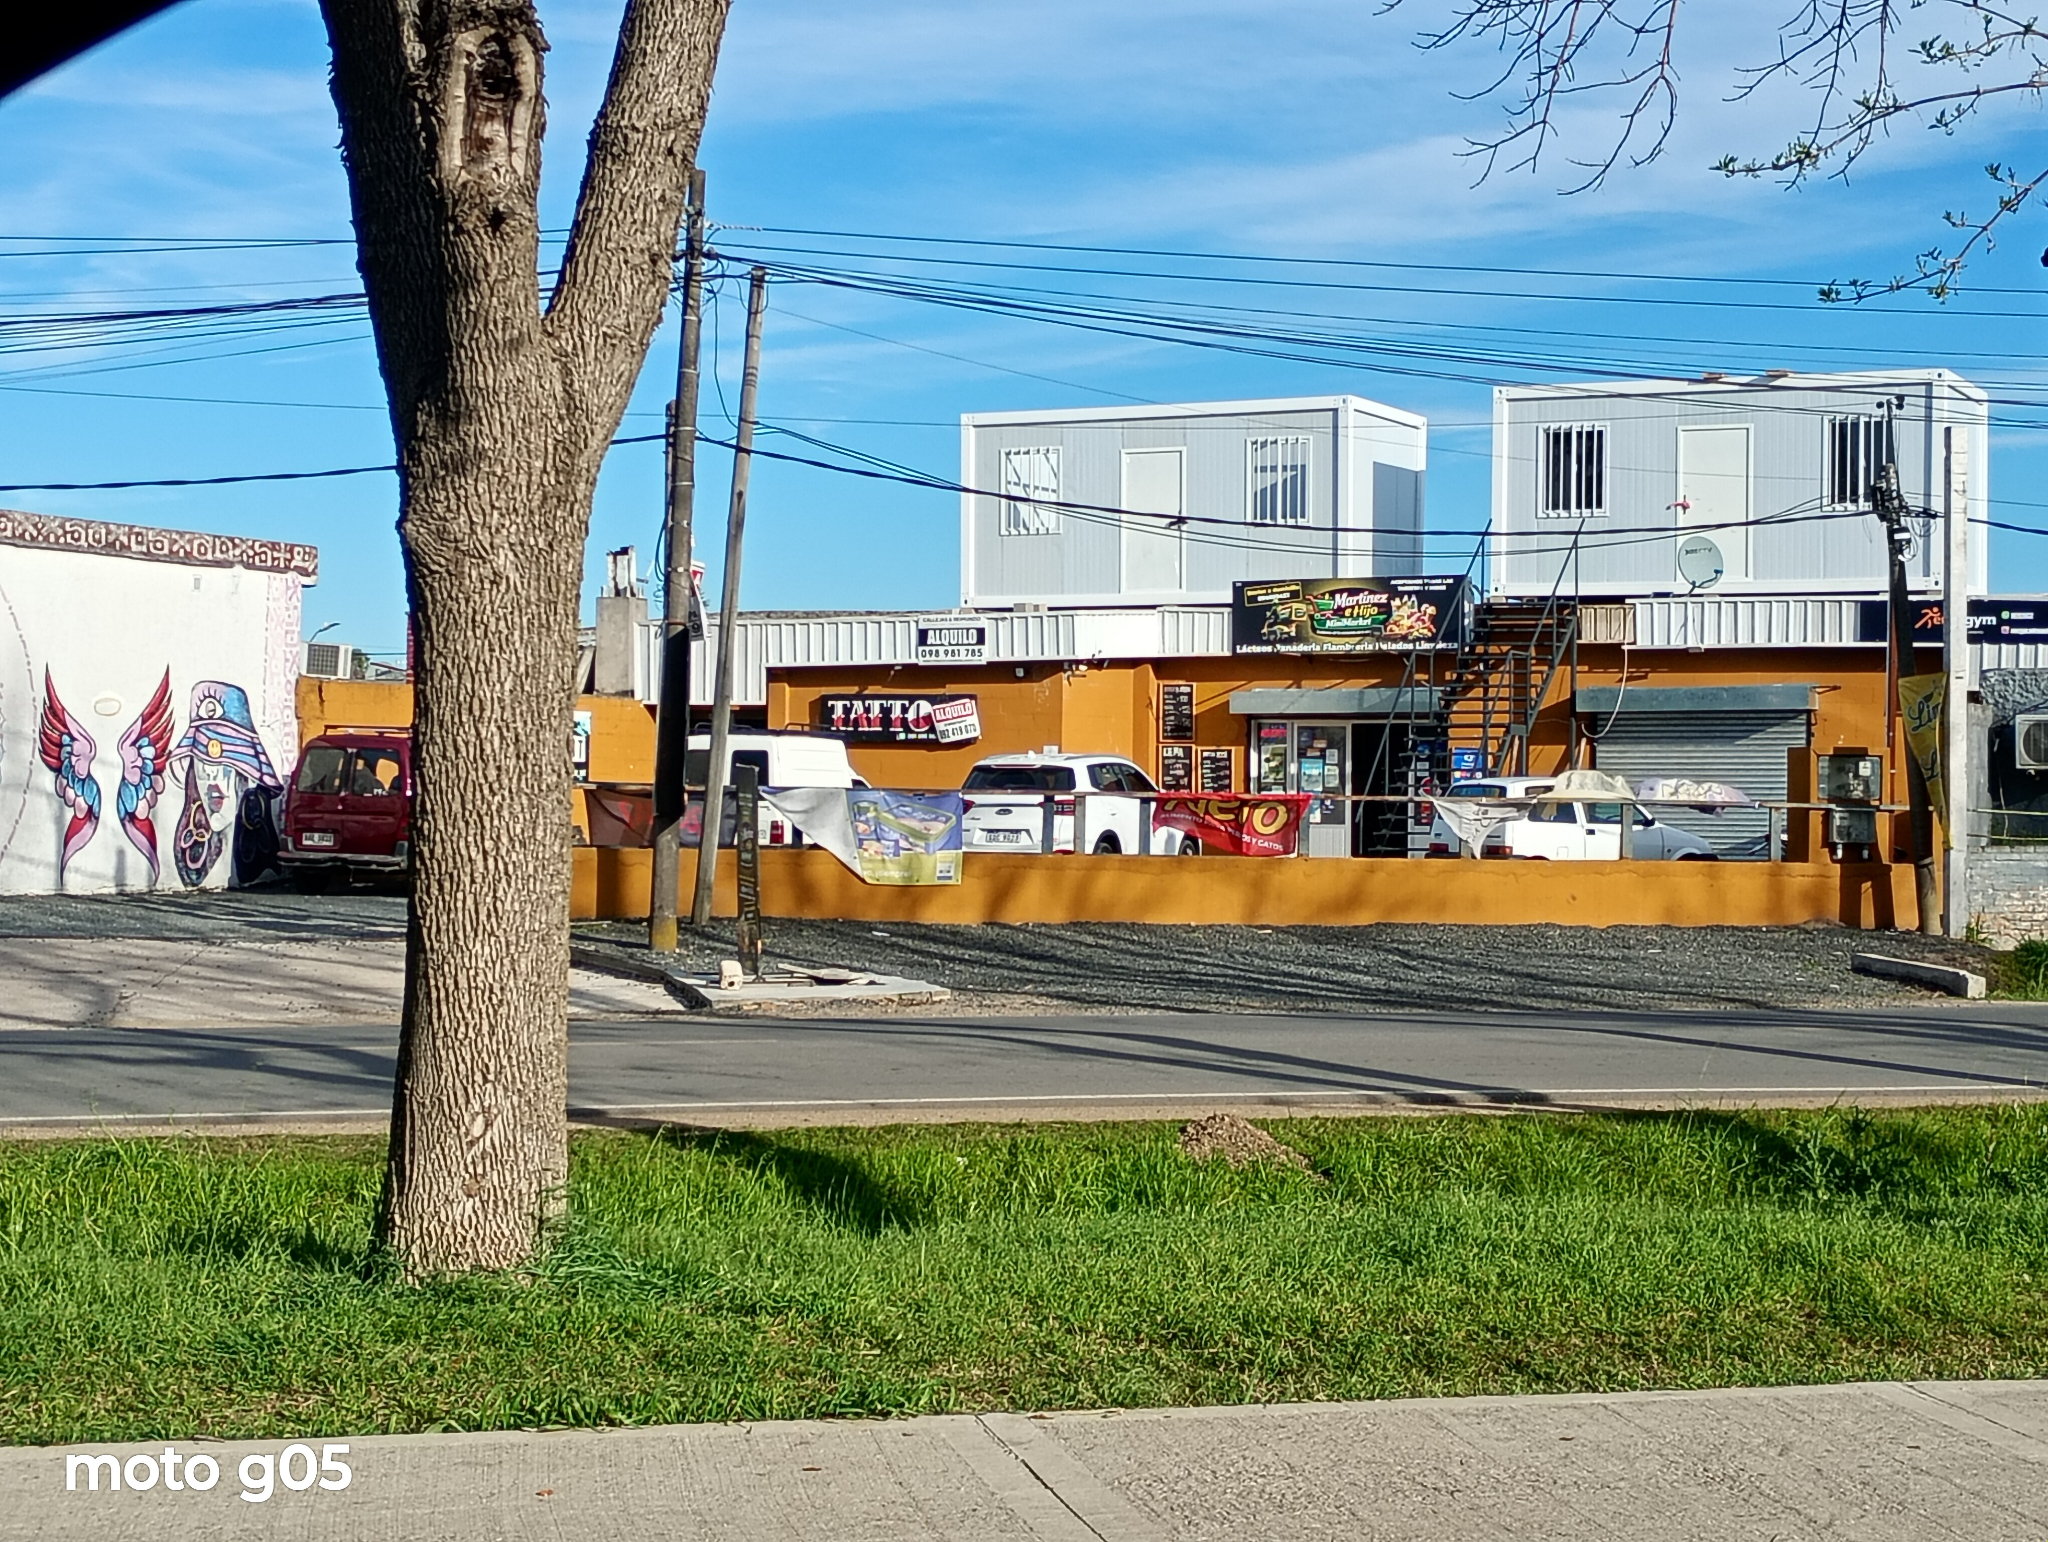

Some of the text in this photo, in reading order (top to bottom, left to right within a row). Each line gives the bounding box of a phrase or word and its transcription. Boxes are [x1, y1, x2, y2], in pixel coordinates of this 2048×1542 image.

[1353, 604, 1378, 618] Hijo
[1966, 616, 1997, 629] gym
[927, 629, 977, 646] ALQUILO
[921, 649, 940, 658] 098
[965, 648, 983, 658] 785
[935, 703, 973, 722] ALQUILO
[1258, 839, 1284, 852] GATOS
